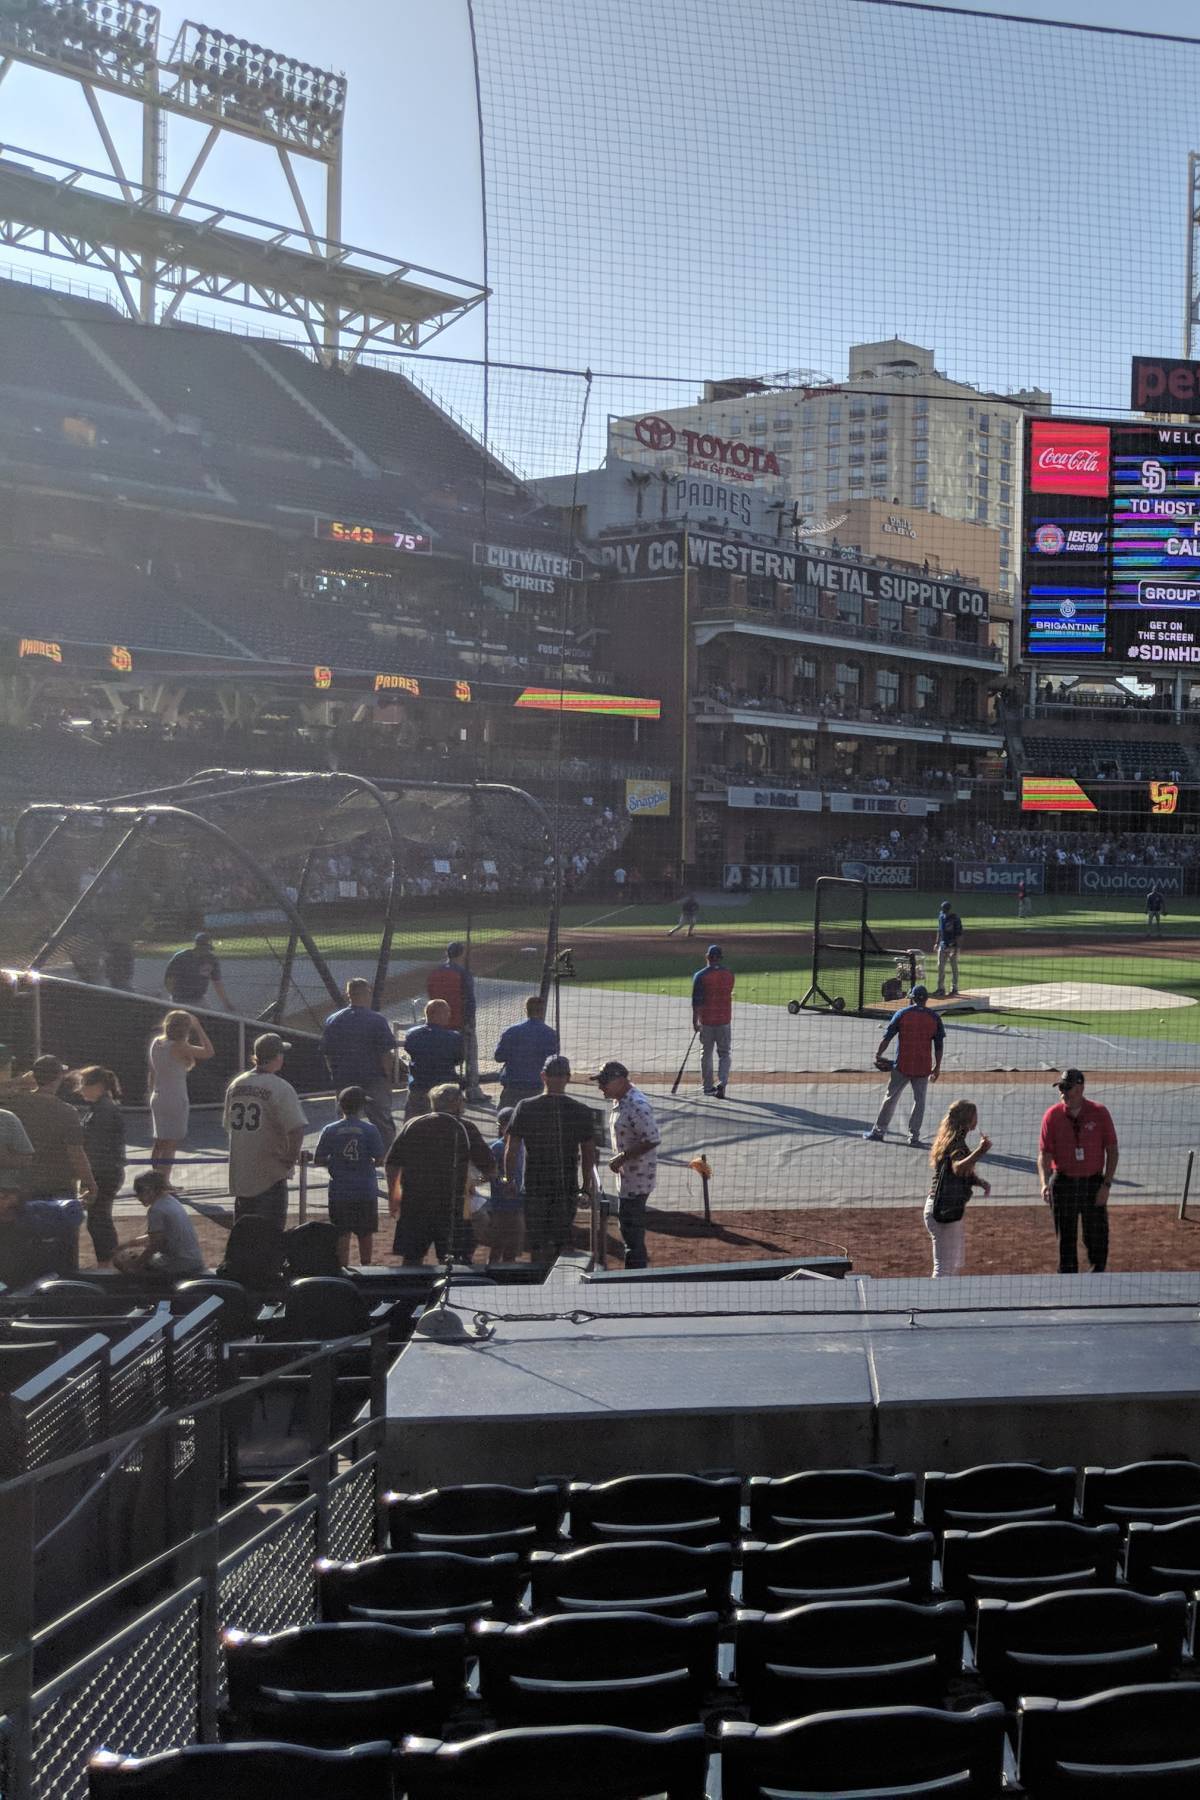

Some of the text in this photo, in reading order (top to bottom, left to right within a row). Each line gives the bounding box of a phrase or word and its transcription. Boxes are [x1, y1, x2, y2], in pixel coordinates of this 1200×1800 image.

[682, 431, 781, 476] TOYOTA
[710, 463, 723, 474] Go
[676, 479, 751, 526] PADRES
[1130, 498, 1150, 513] TO
[1155, 500, 1195, 515] HOST
[332, 522, 374, 544] 5:43
[1067, 531, 1103, 544] IBEW
[648, 539, 683, 571] CO.
[1066, 542, 1085, 552] Local
[503, 573, 555, 593] SPIRITS
[688, 536, 988, 618] WESTERN METAL SUPPLY CO.
[1036, 621, 1100, 632] BRIGANTINE
[1149, 621, 1183, 631] GET ON
[1138, 631, 1194, 642] THE SCREEN
[19, 639, 63, 663] PADRES
[374, 674, 420, 696] PADRES
[629, 789, 668, 811] Snapple
[867, 866, 911, 876] ROCKET
[867, 874, 912, 884] LEAGUE
[1083, 870, 1180, 890] Qualcomm
[231, 1102, 262, 1131] 33
[342, 1138, 359, 1161] 4
